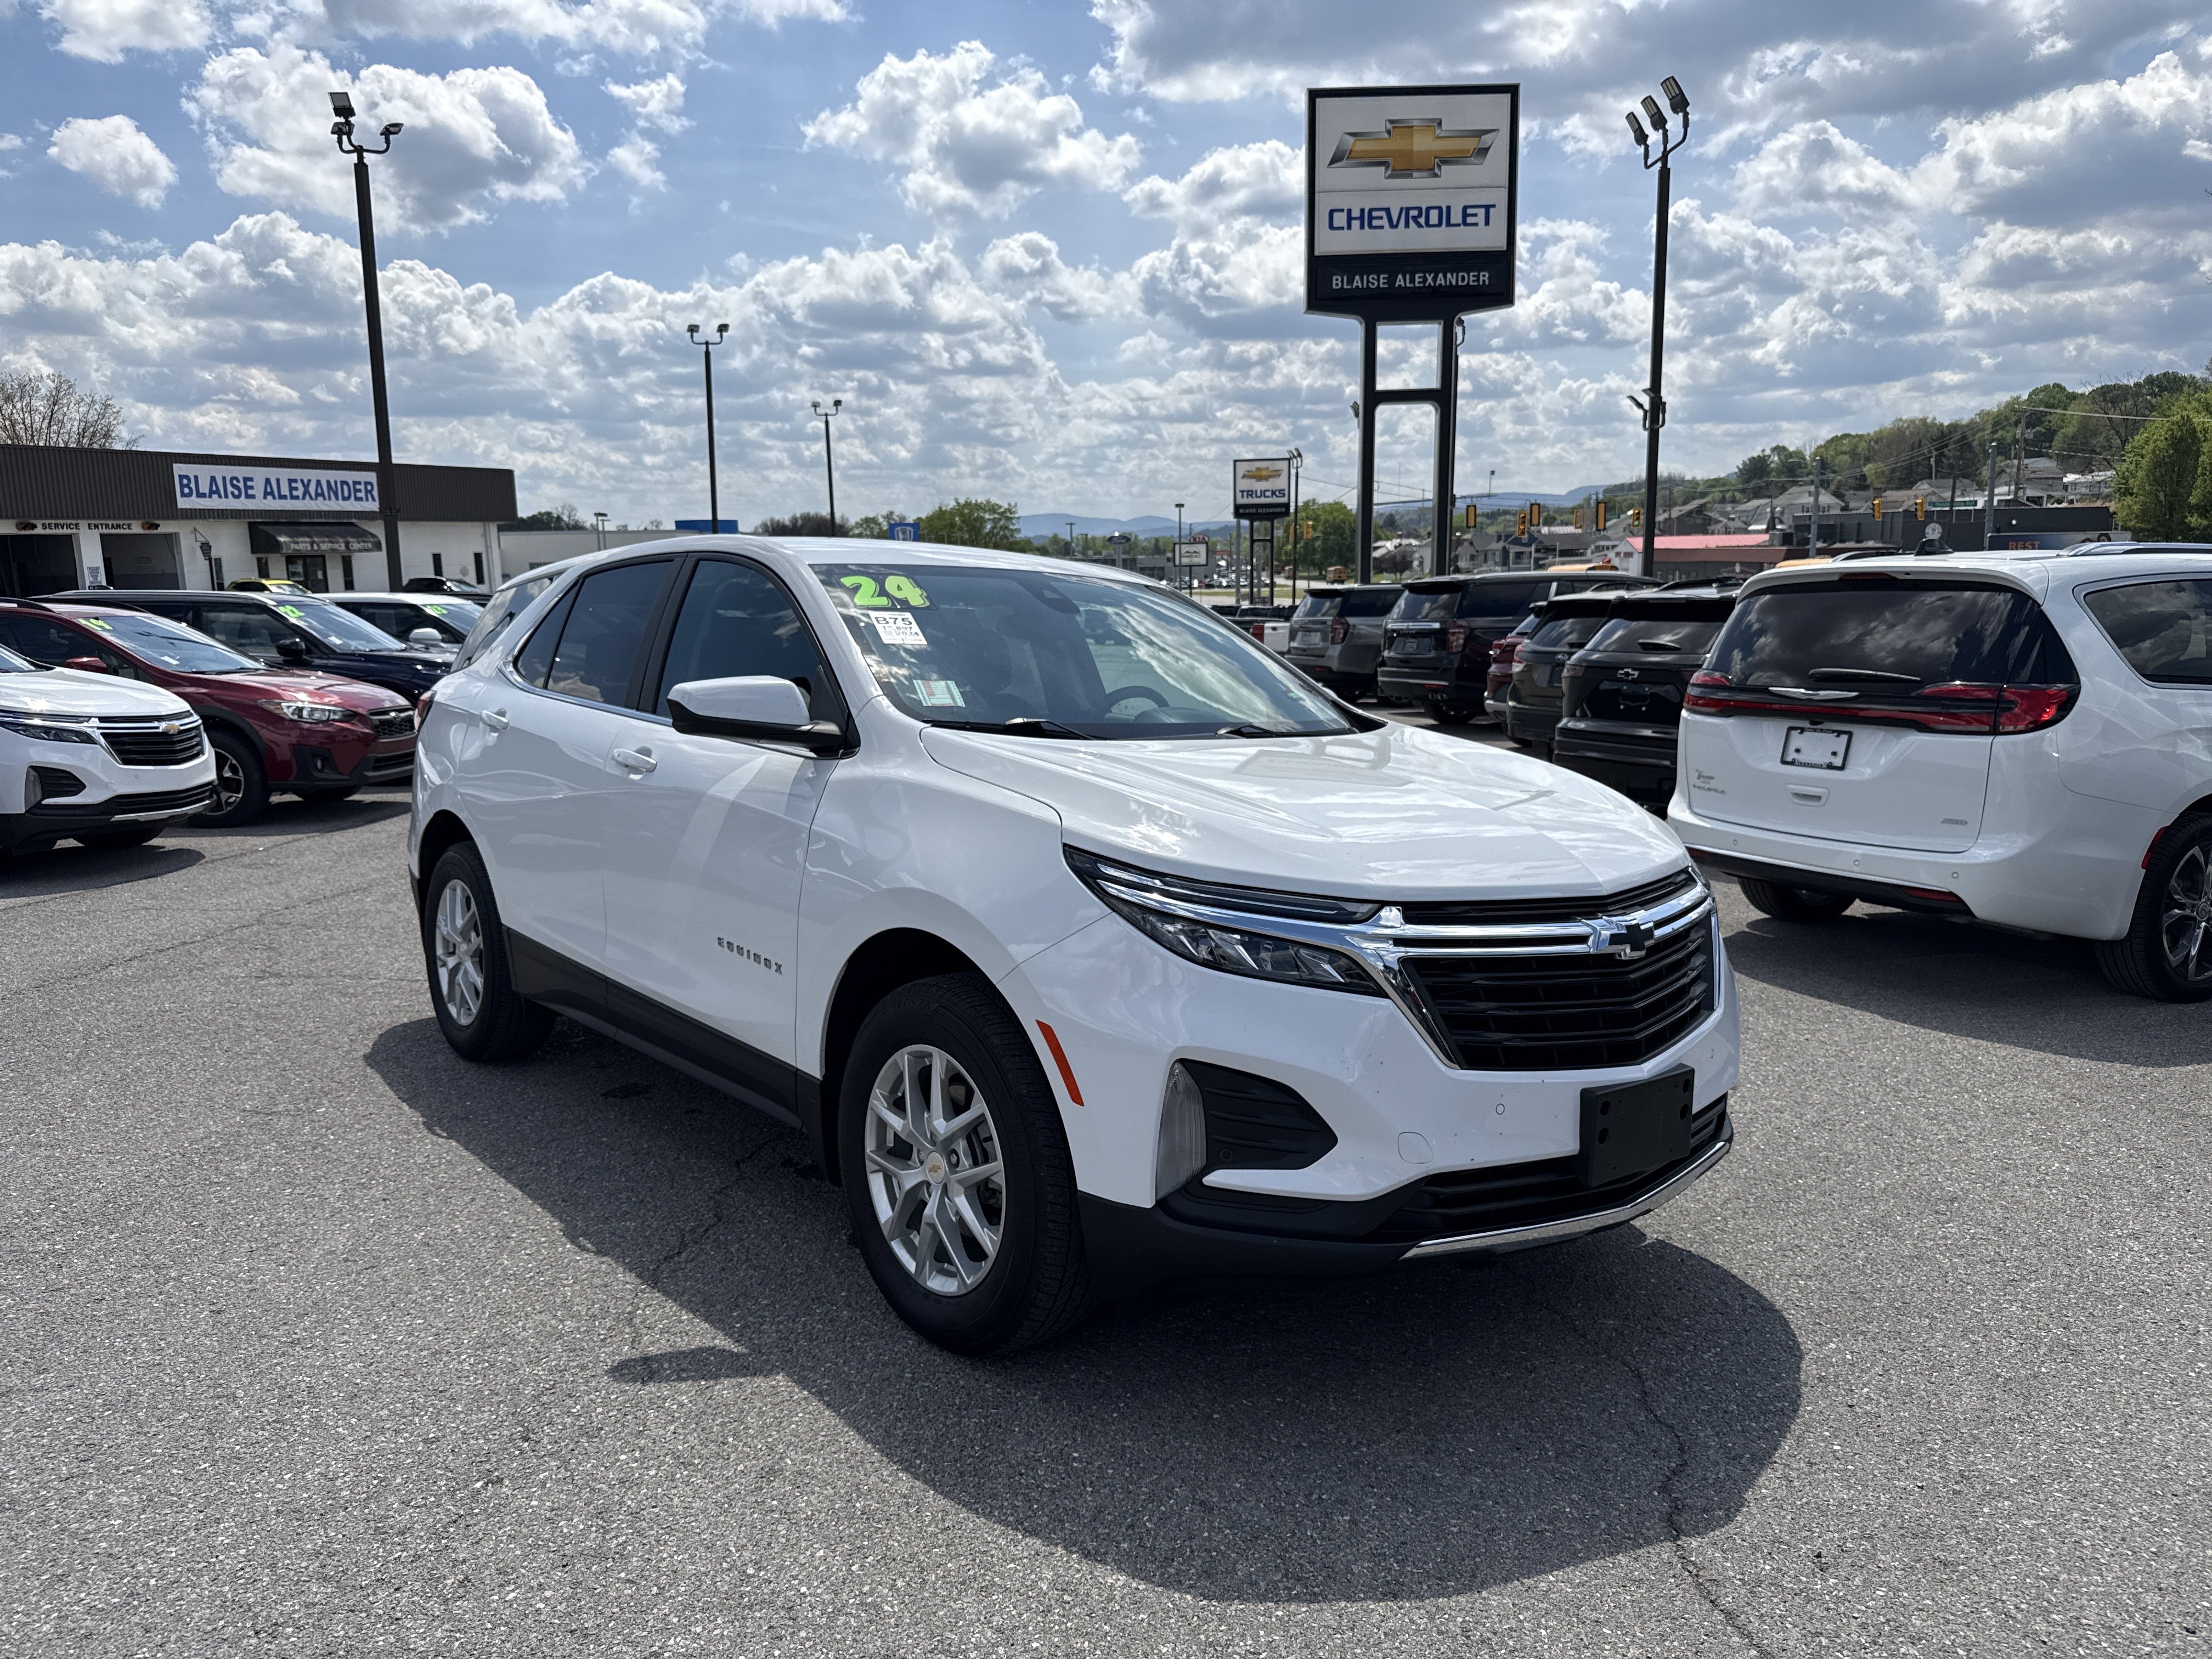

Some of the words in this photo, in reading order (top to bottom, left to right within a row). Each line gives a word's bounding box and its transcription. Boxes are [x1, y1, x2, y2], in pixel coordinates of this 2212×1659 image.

[1328, 204, 1496, 231] CHEVROLET
[1332, 274, 1389, 289] BLAISE
[1395, 272, 1489, 287] ALEXANDER
[178, 474, 256, 499] BLAISE
[263, 477, 377, 502] ALEXANDER
[1239, 489, 1285, 499] TRUCKS
[840, 575, 930, 608] 24
[874, 617, 912, 625] B75
[717, 936, 783, 975] EQUINOX
